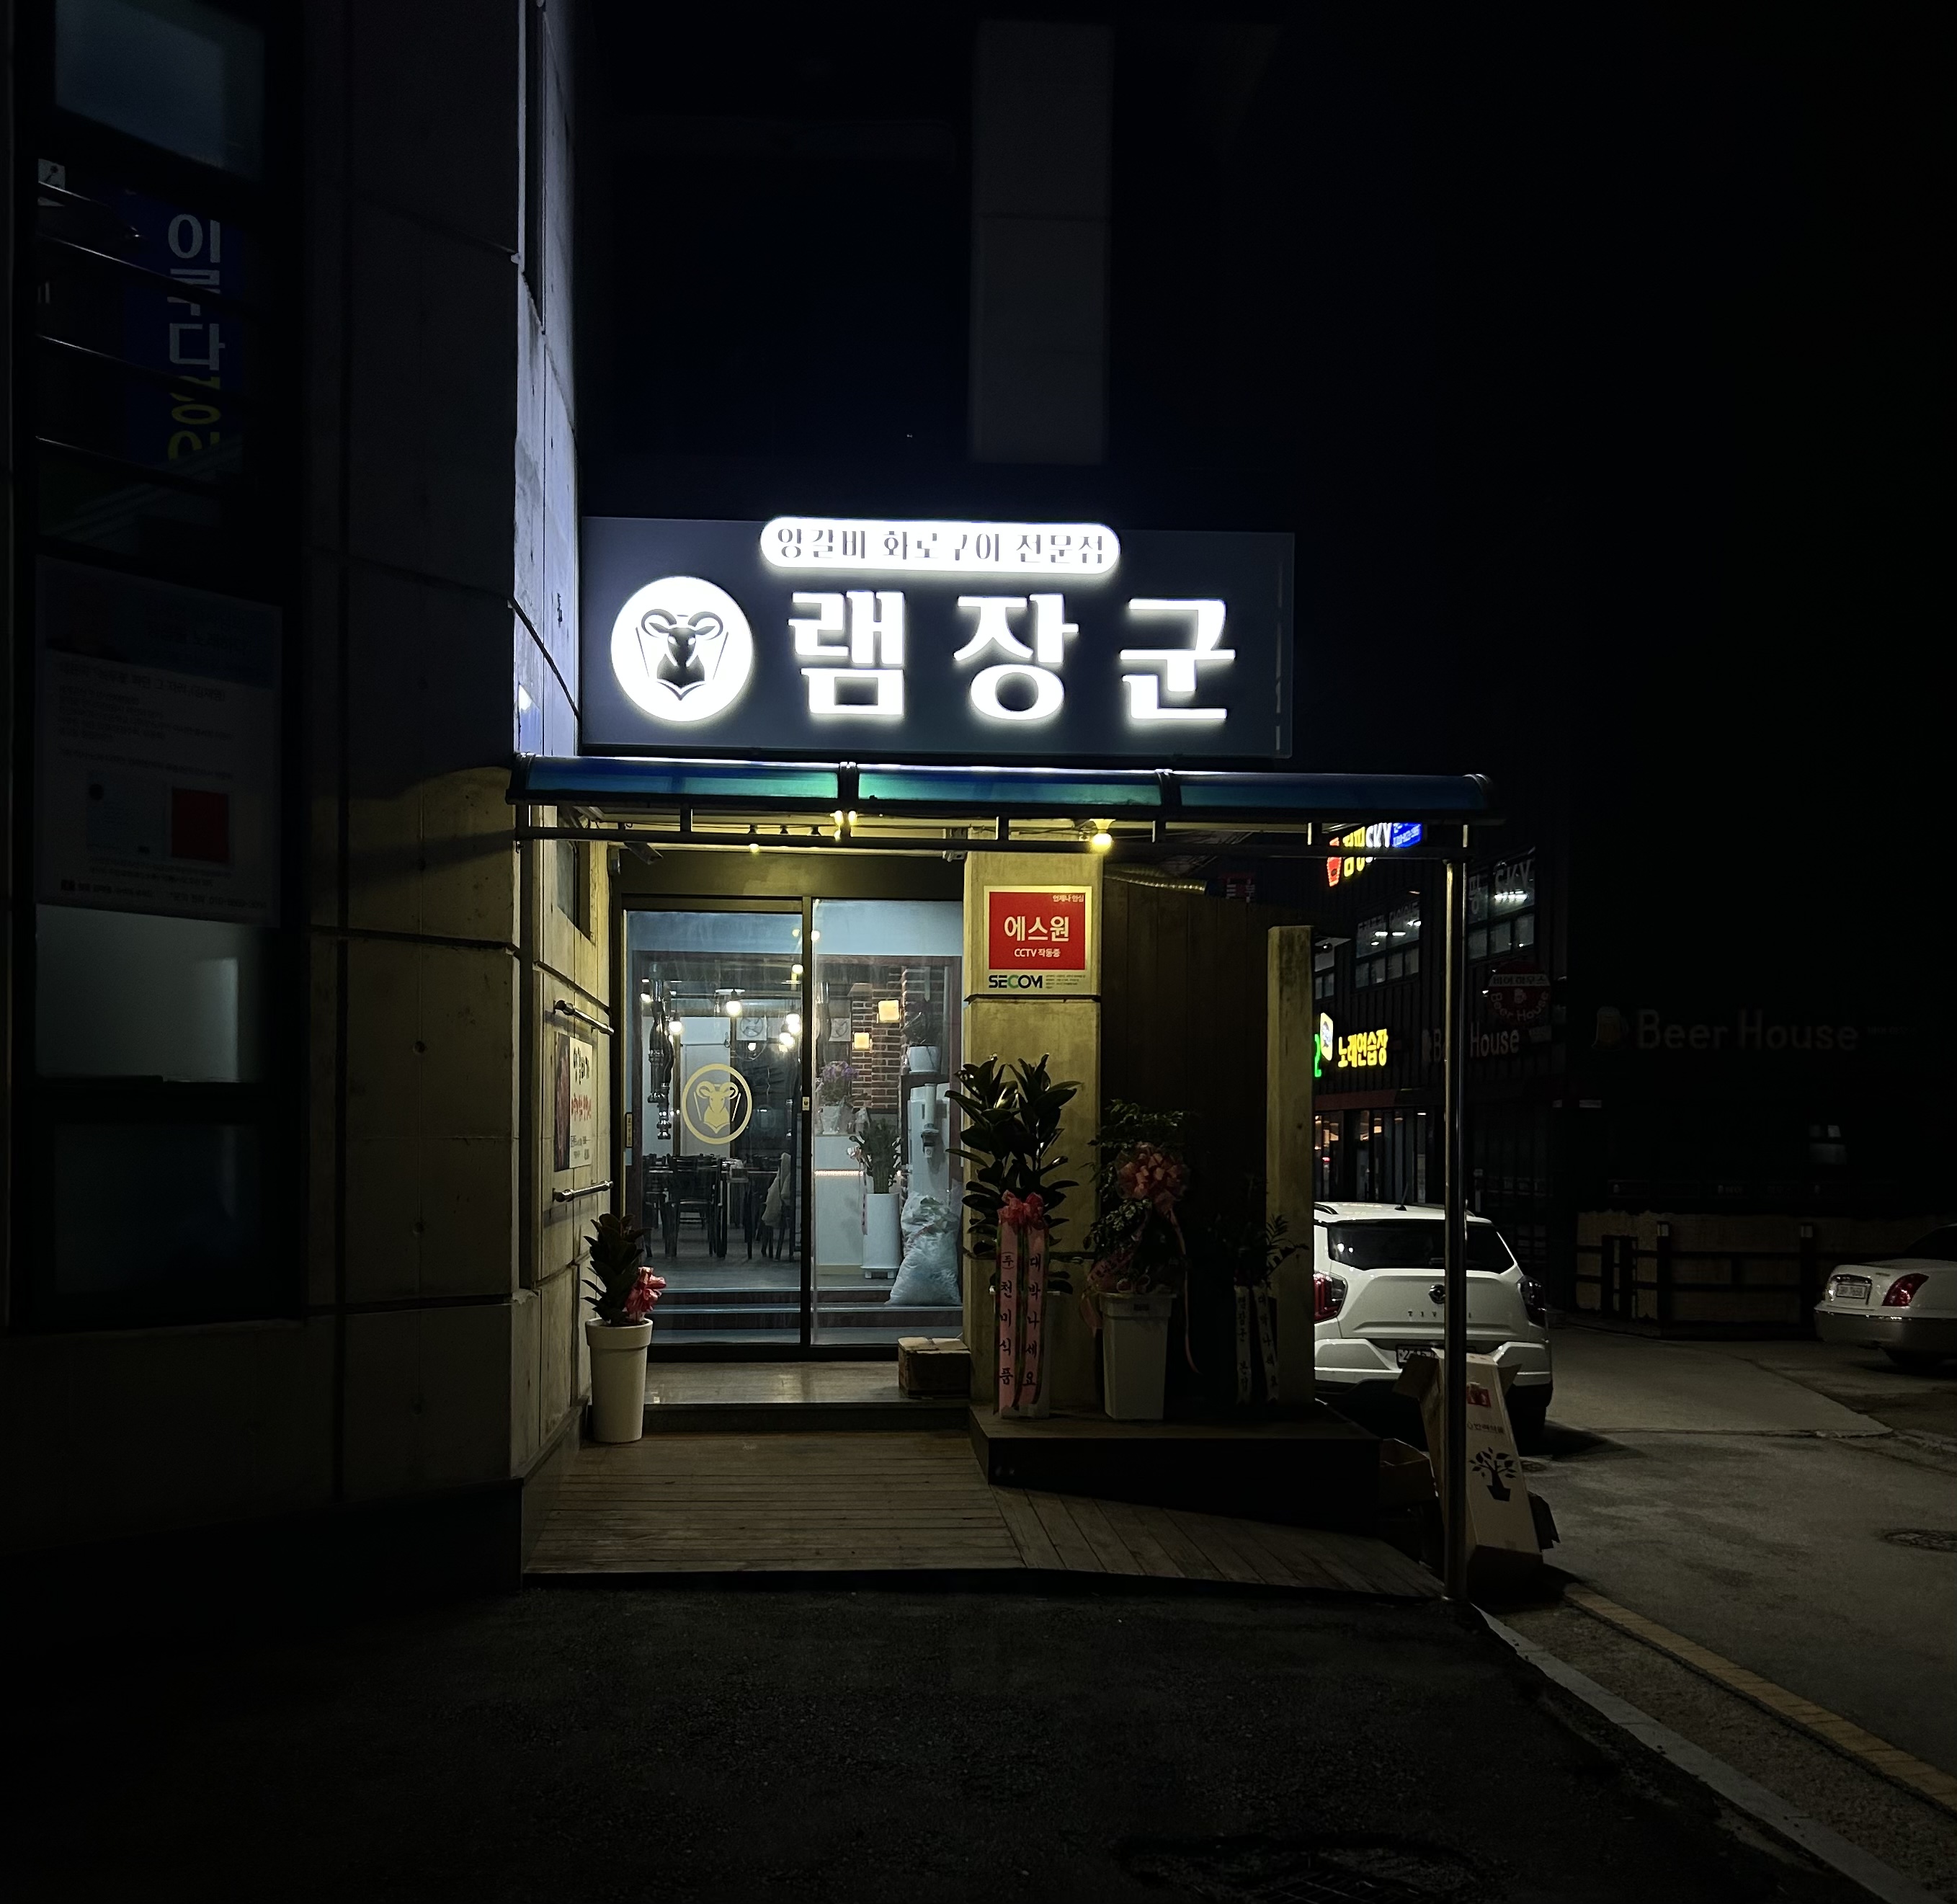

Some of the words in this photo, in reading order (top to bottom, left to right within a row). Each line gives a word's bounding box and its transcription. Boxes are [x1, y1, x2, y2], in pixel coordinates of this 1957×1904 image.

[777, 528, 865, 559] 양갈비
[883, 530, 999, 562] 화로구이
[1016, 533, 1103, 564] 전문점
[788, 590, 1236, 722] 램장군
[1004, 915, 1069, 942] 에스원
[1014, 948, 1038, 958] CCTV
[1038, 948, 1061, 958] 작동중
[989, 975, 1043, 989] SECOM
[1490, 992, 1514, 1019] Beer
[1469, 1022, 1520, 1059] House
[1636, 1009, 1729, 1050] Beer
[1738, 1006, 1859, 1051] House
[1338, 1028, 1389, 1068] 노래연습장
[1022, 1253, 1041, 1387] 대박나세요
[1407, 1310, 1471, 1319] TIVI
